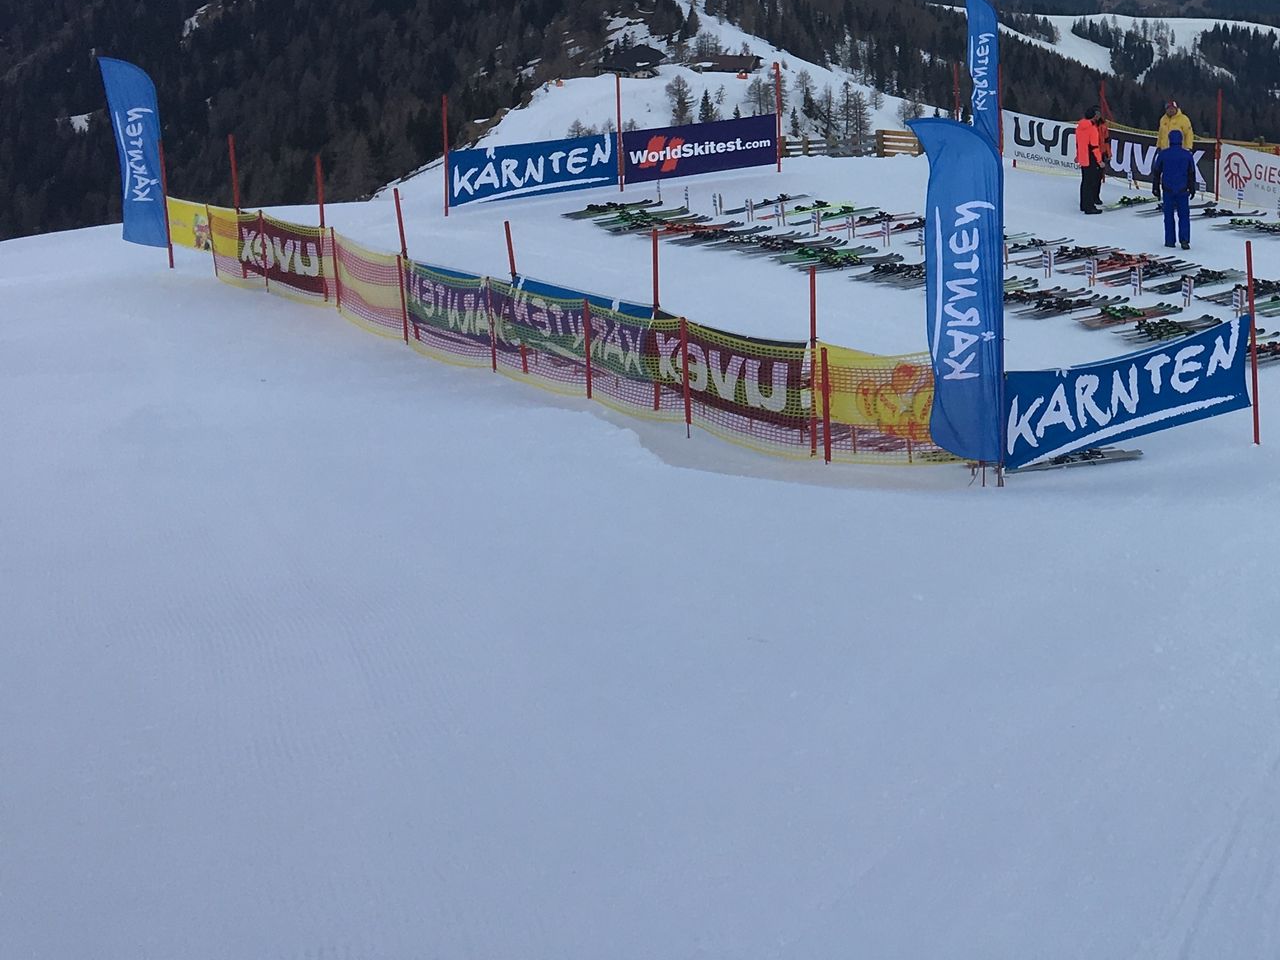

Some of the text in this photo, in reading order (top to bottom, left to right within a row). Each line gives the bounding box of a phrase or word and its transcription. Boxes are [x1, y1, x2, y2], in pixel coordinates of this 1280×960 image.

[453, 134, 612, 198] KÄRNTEN
[629, 137, 771, 165] WorldSkitest.com
[1110, 138, 1206, 183] uvx
[1007, 318, 1240, 456] KÄRNTEN
